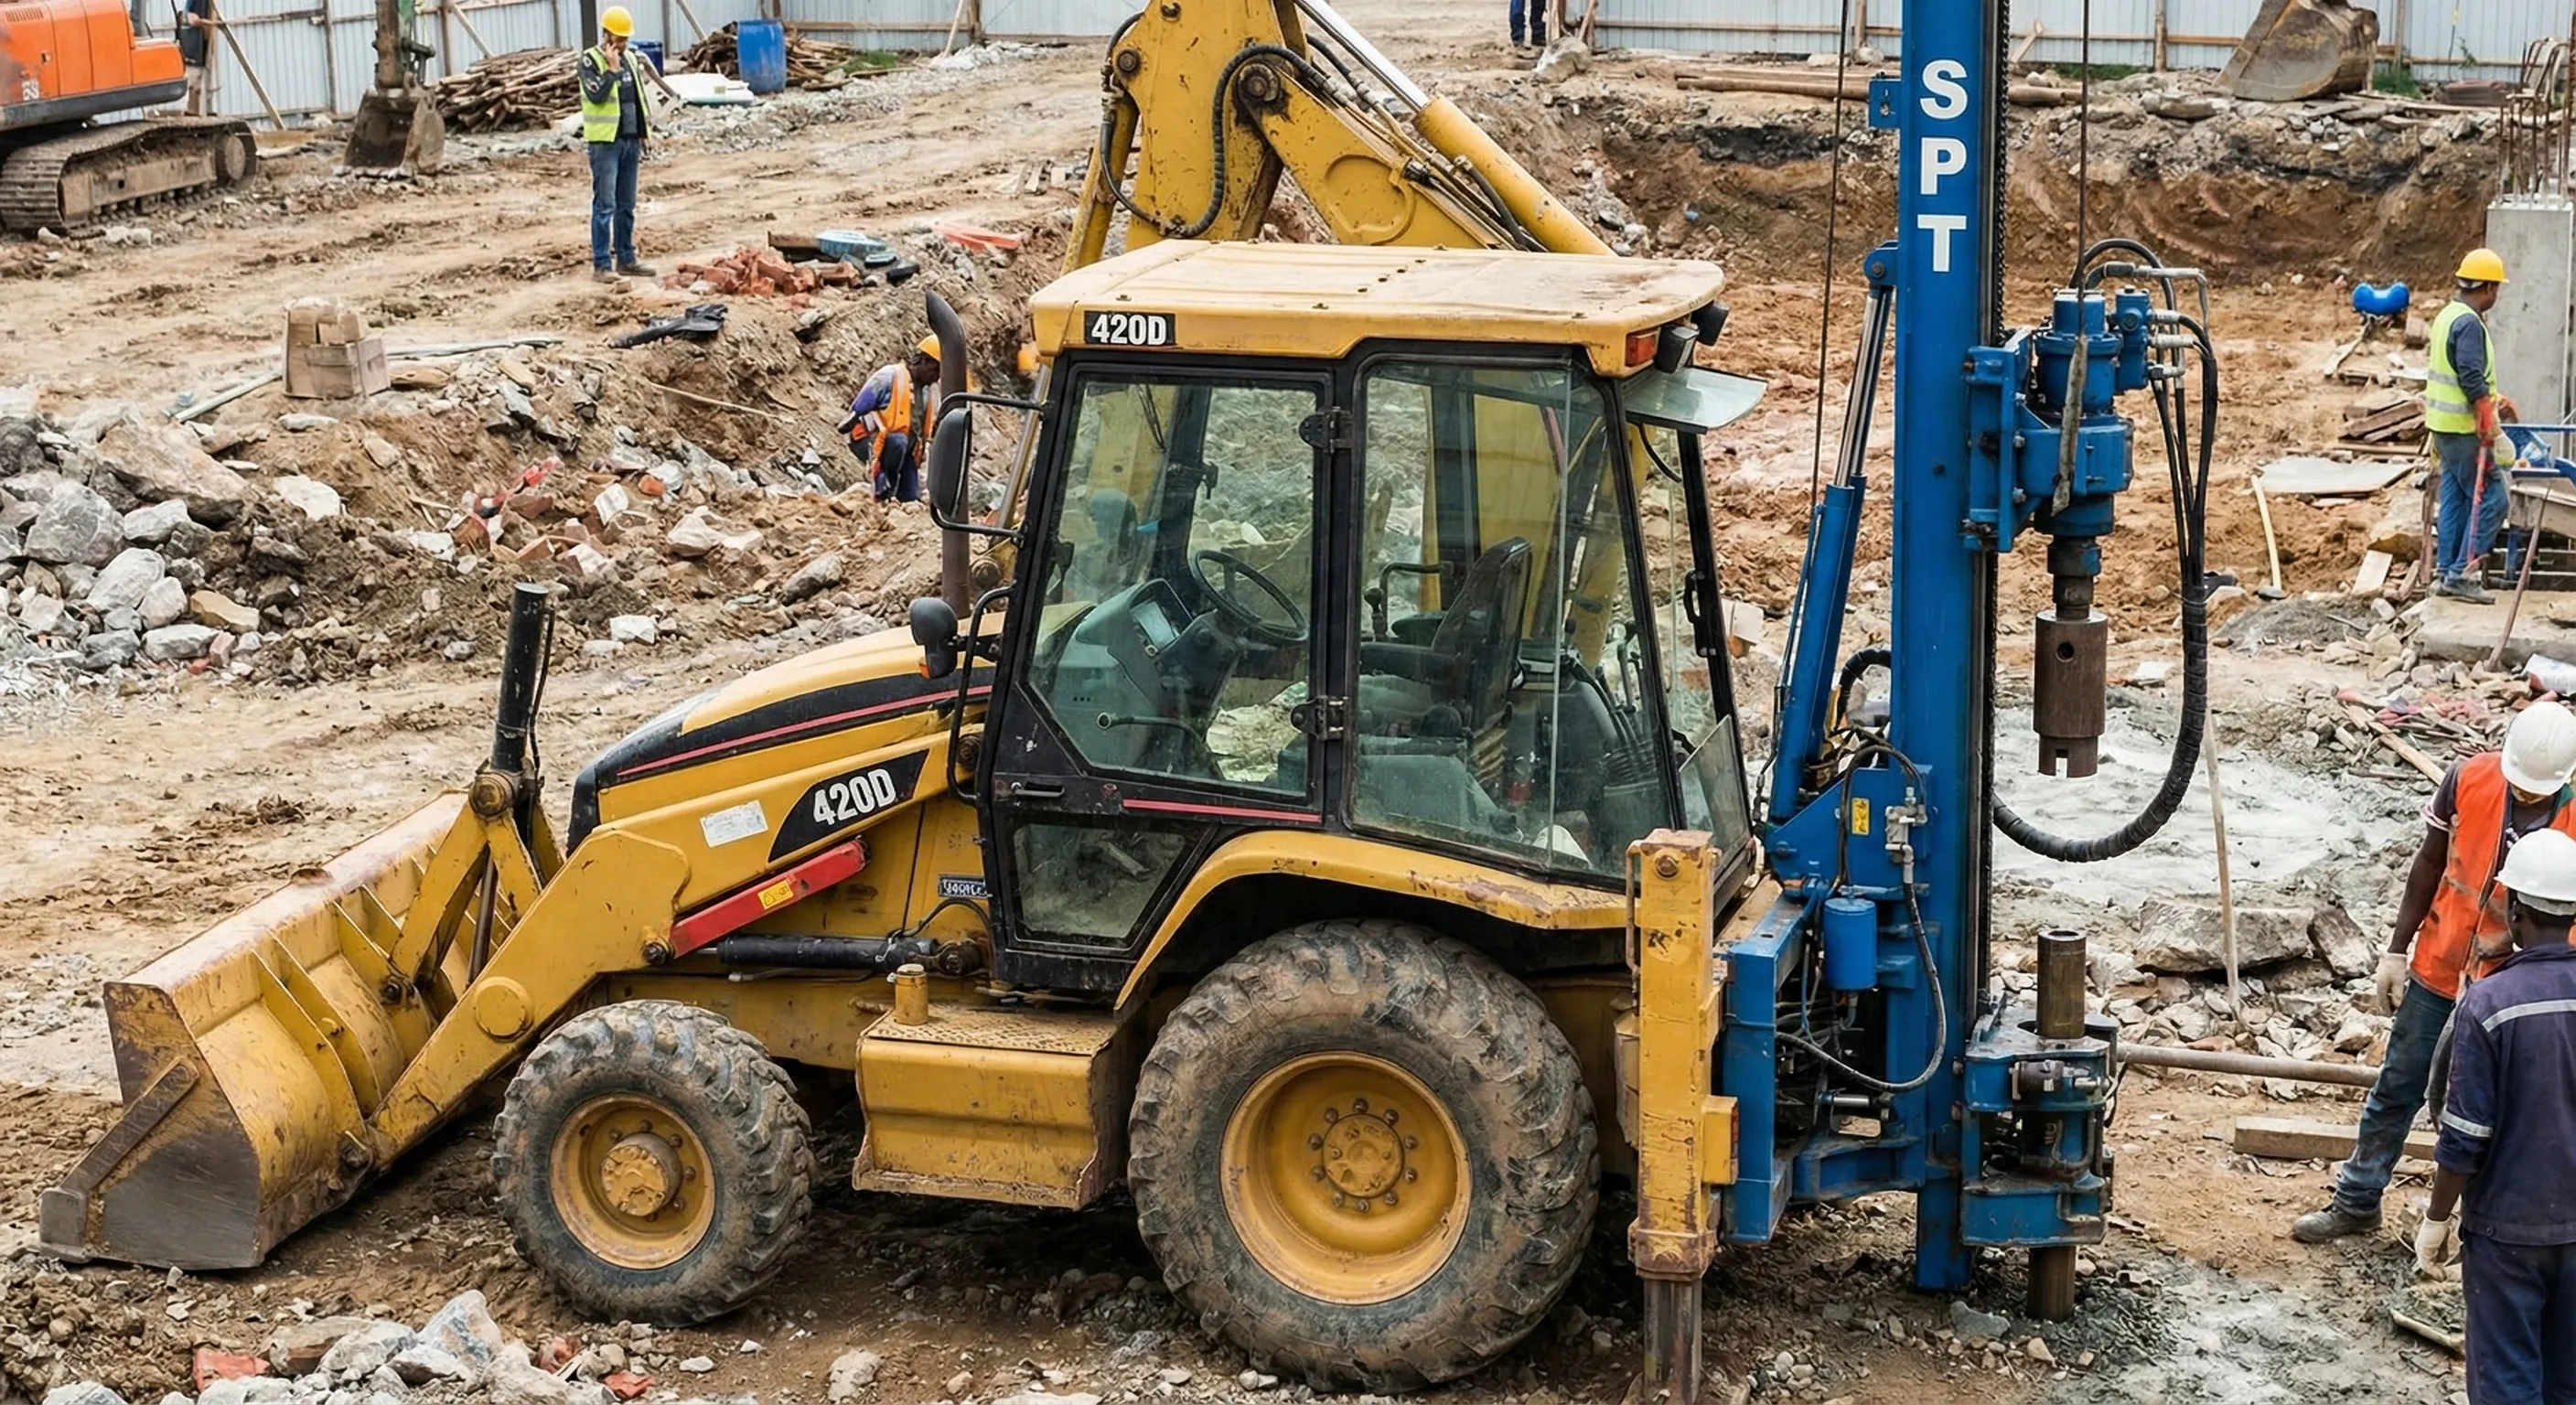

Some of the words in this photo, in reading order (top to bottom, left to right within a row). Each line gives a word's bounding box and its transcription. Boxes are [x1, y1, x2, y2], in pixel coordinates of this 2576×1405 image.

[1917, 59, 1968, 273] SPT
[1091, 314, 1166, 345] 420D
[813, 768, 896, 825] 420D
